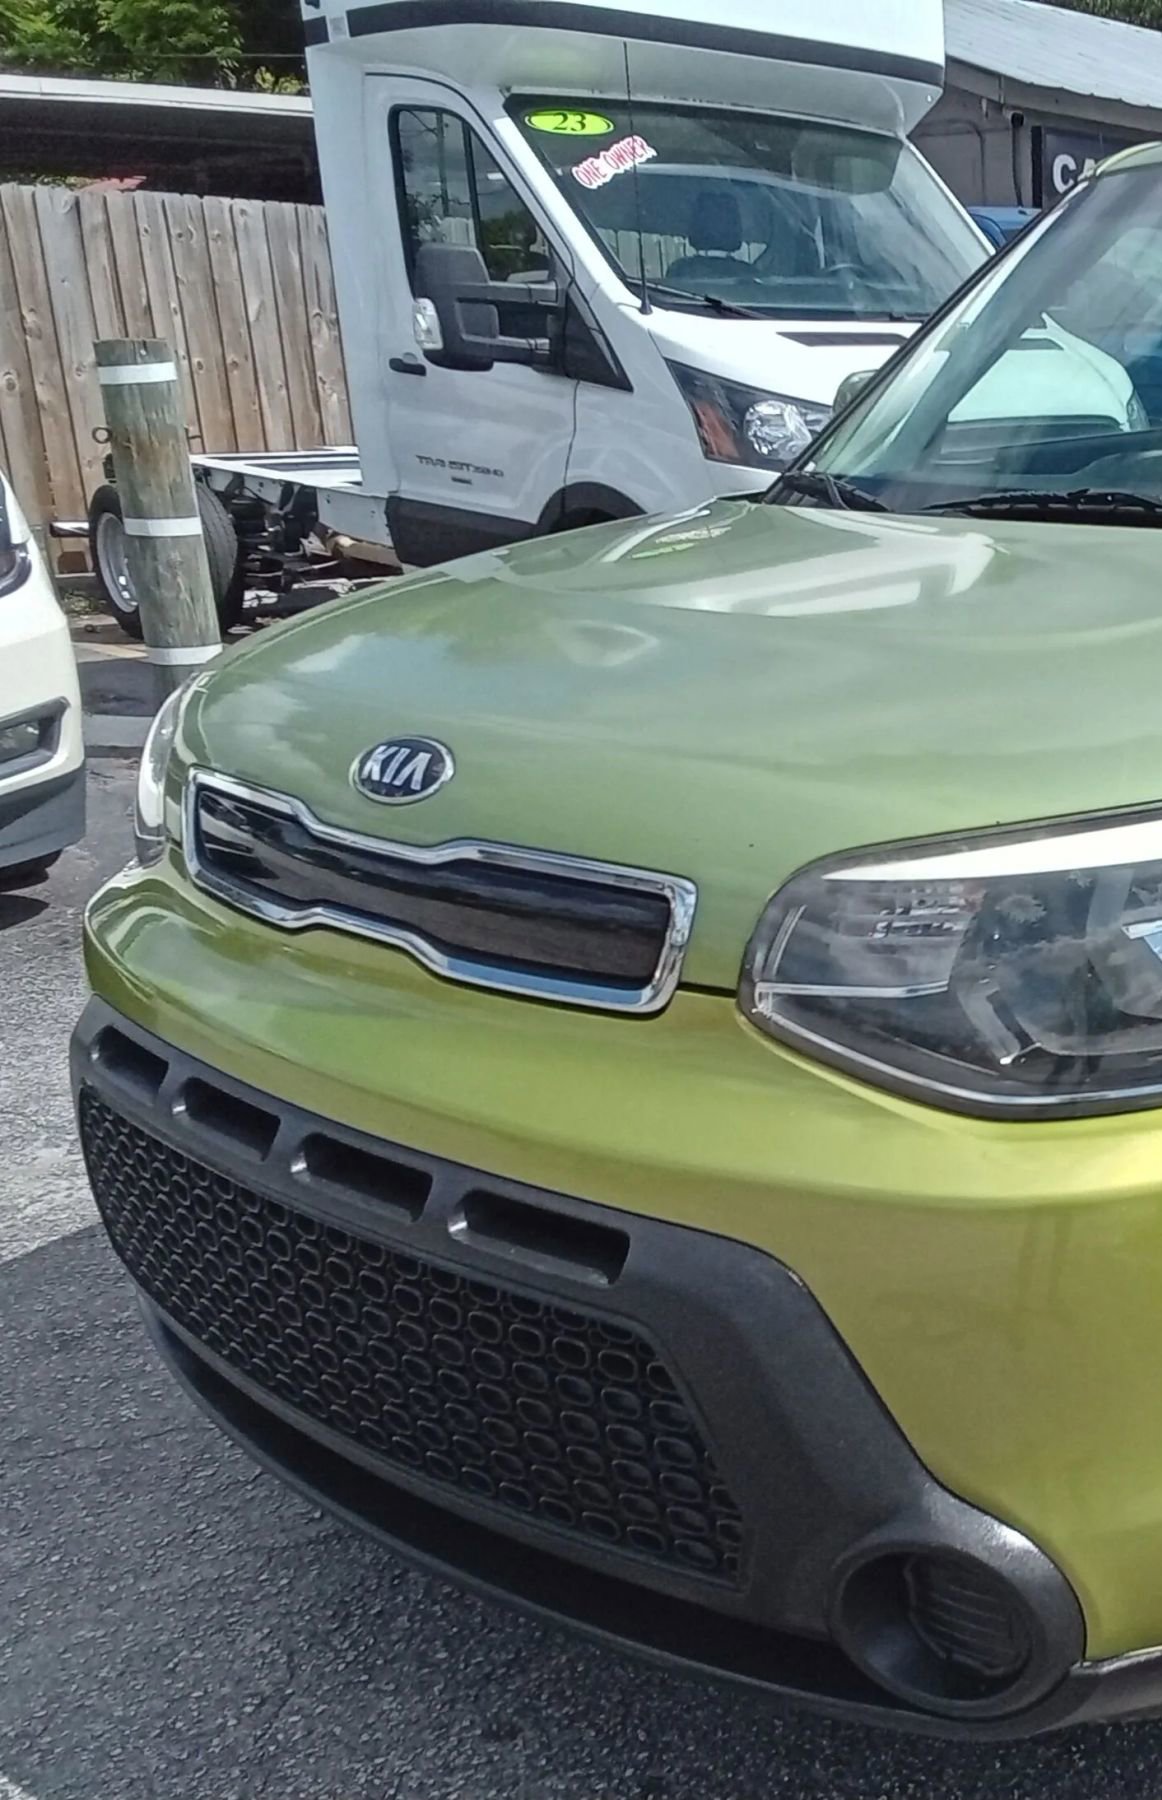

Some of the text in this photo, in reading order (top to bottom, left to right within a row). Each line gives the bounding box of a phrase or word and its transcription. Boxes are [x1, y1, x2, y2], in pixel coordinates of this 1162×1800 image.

[552, 111, 587, 132] 23
[574, 138, 650, 187] ONE OWNER
[360, 744, 433, 792] KIA
